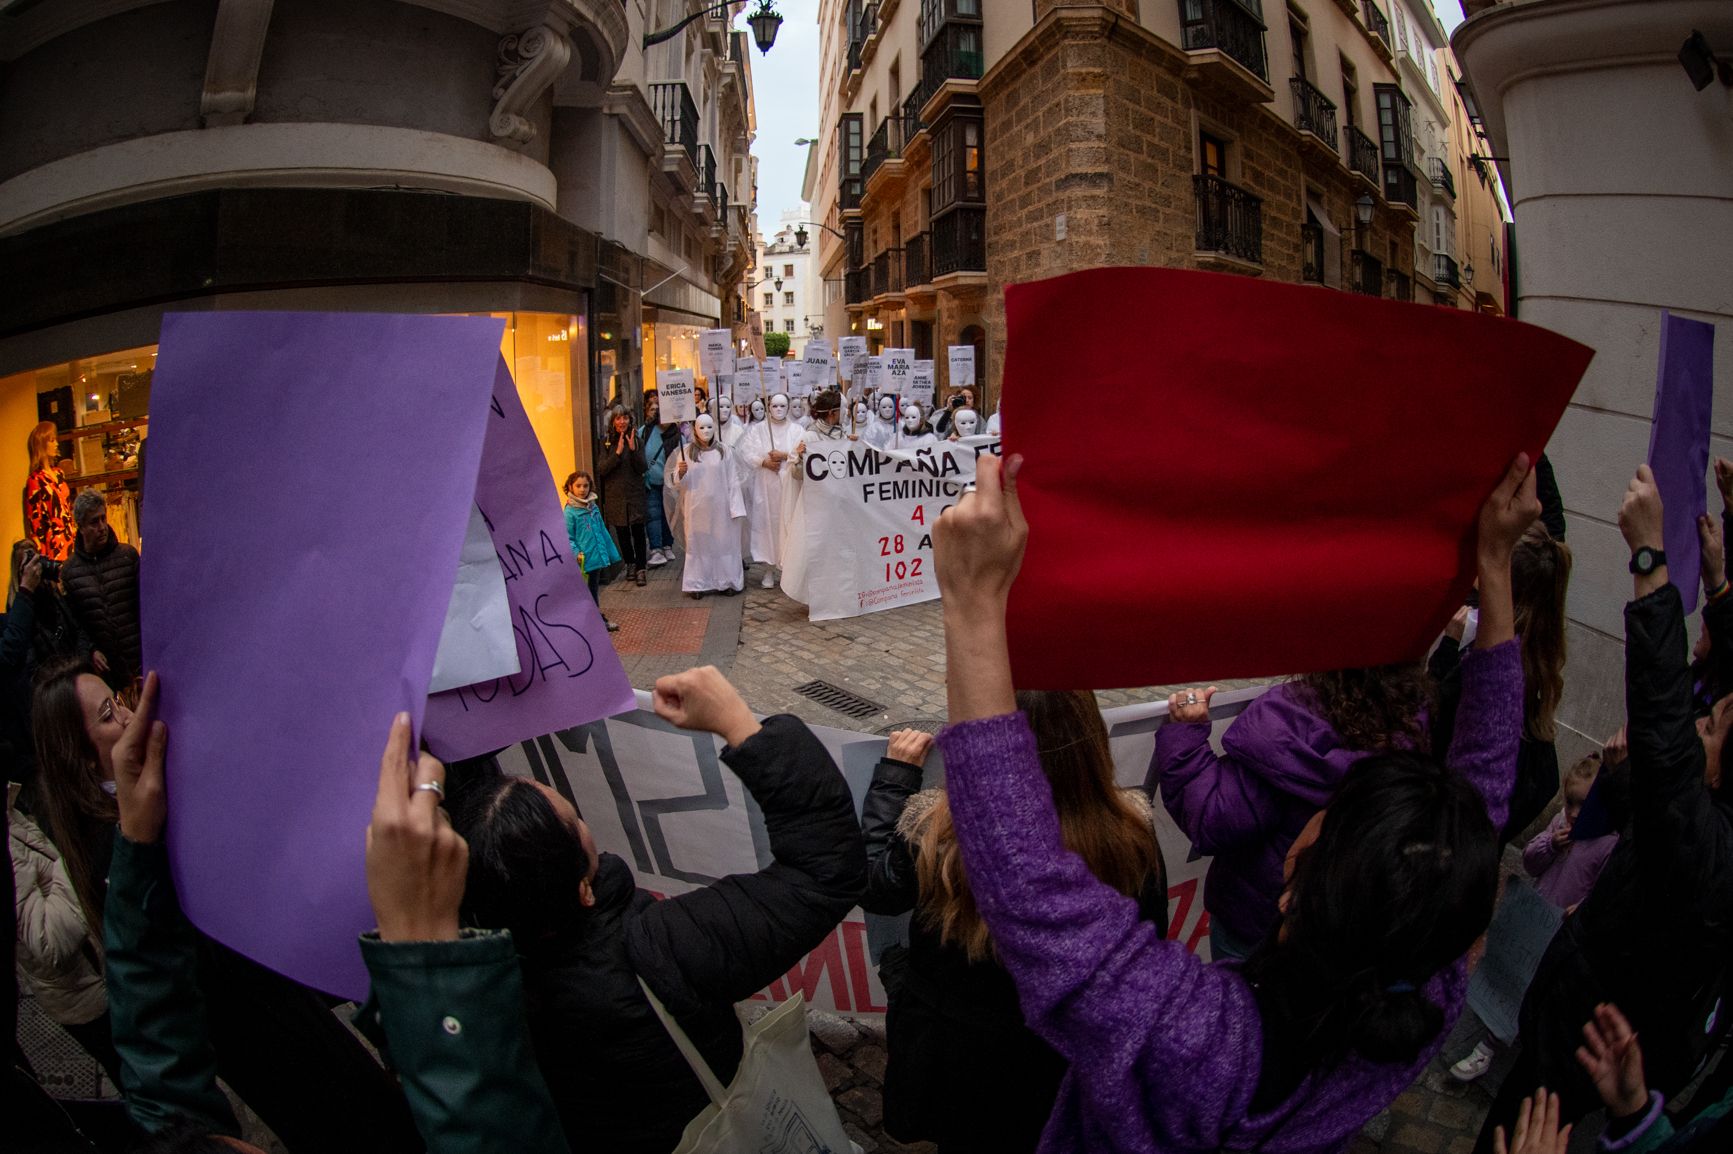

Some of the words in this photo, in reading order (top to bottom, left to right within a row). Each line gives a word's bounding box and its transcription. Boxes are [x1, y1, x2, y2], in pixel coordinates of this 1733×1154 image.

[806, 357, 828, 365] JUANI
[661, 388, 692, 397] VANESSA
[666, 382, 686, 390] ERICA
[862, 479, 967, 503] FEMINIC
[911, 504, 924, 526] 4
[540, 529, 563, 567] A
[878, 534, 905, 557] 28
[885, 557, 923, 582] 102
